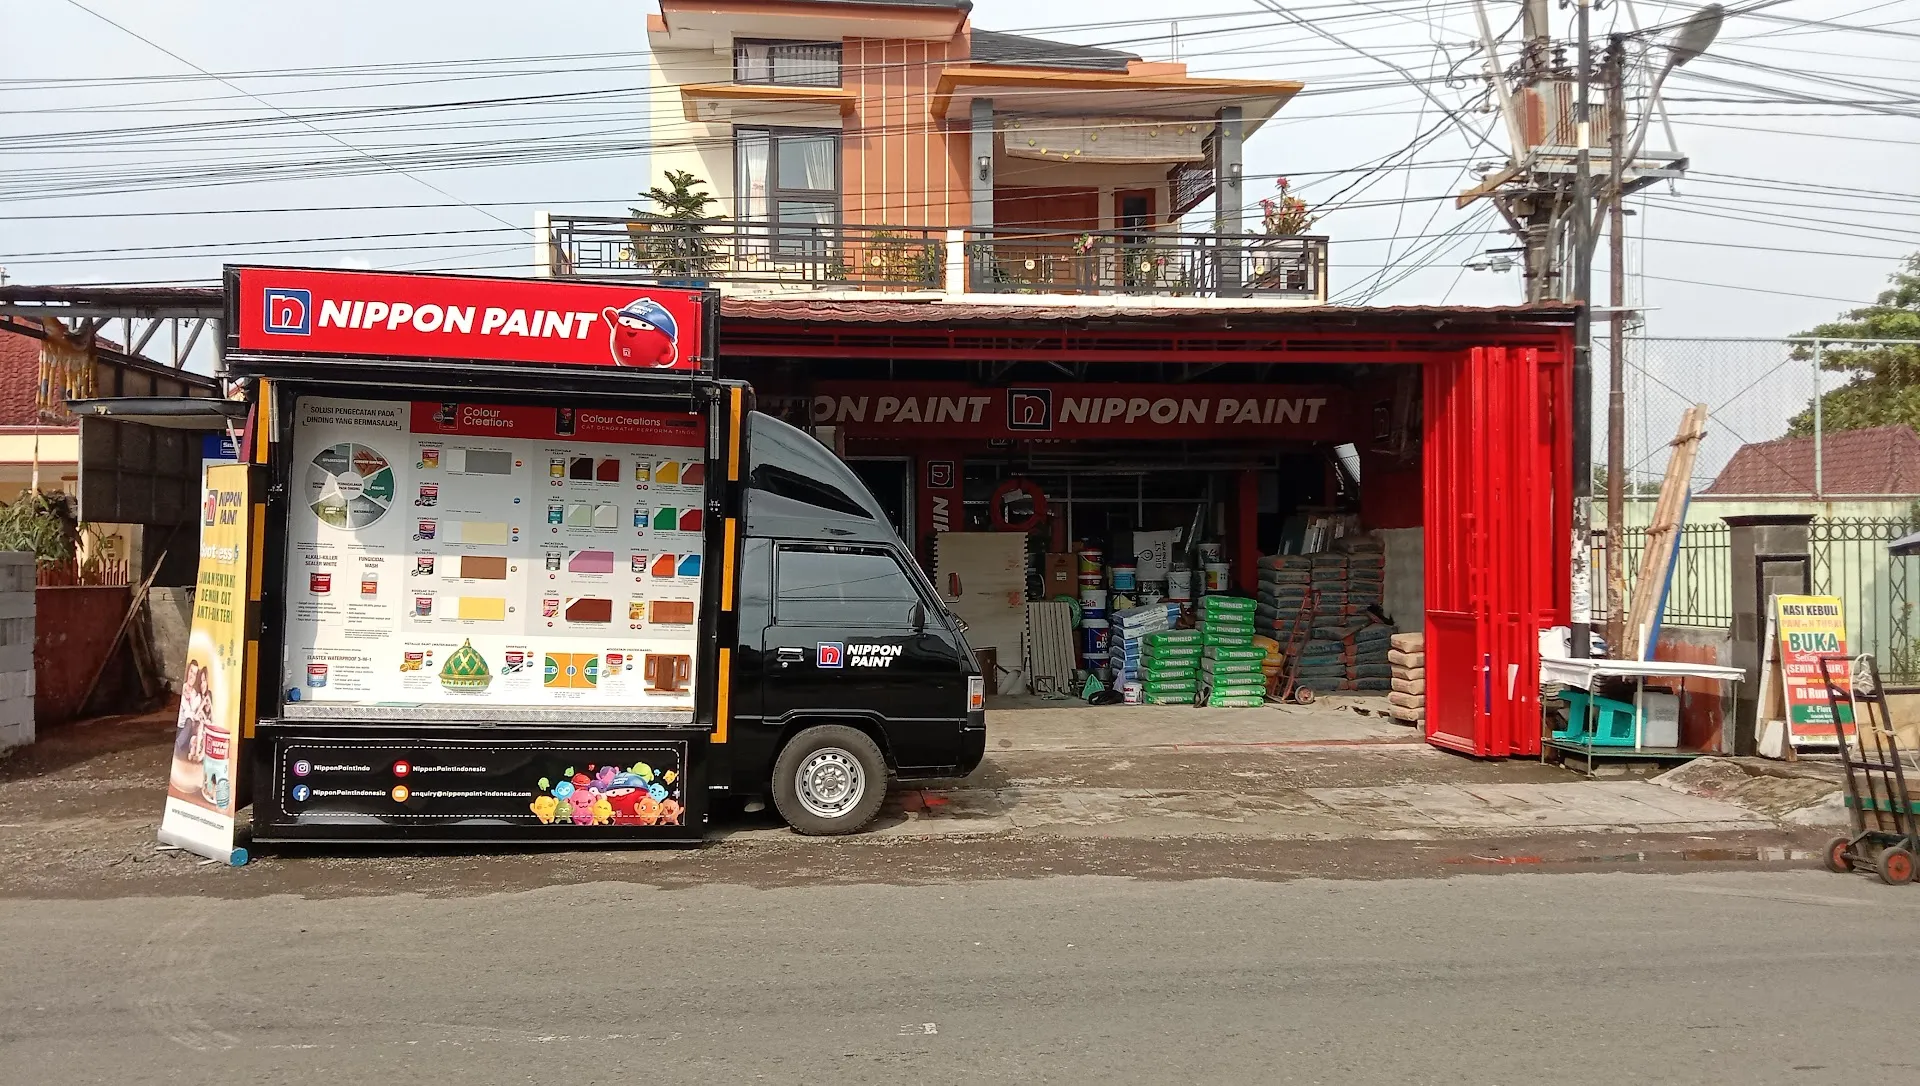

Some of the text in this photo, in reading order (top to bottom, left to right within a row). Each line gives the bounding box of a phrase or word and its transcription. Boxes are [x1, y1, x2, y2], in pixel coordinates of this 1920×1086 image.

[318, 299, 479, 334] NIPPON
[481, 306, 599, 341] PAINT
[310, 406, 395, 417] SOLUSI PENGECATAN PADA
[463, 406, 501, 418] Colour
[874, 396, 991, 423] PAINT
[1058, 397, 1210, 424] NIPPON
[1215, 398, 1327, 424] PAINT
[306, 417, 398, 428] DINDING YANG BERMASALAH
[463, 416, 514, 428] Creations
[580, 413, 614, 424] Colour
[615, 416, 661, 427] Creations
[1782, 604, 1839, 616] NASI KEBULI
[1789, 632, 1840, 653] BUKA
[846, 644, 903, 657] NIPPON
[850, 656, 893, 667] PAINT
[1794, 653, 1818, 663] Setiap
[1786, 664, 1814, 675] (SENIN
[1796, 687, 1807, 699] Di
[313, 764, 371, 772] NipponPaintIndo
[412, 765, 487, 773] NipponPaintIndonesia
[312, 789, 386, 797] NipponPaintIndonesia
